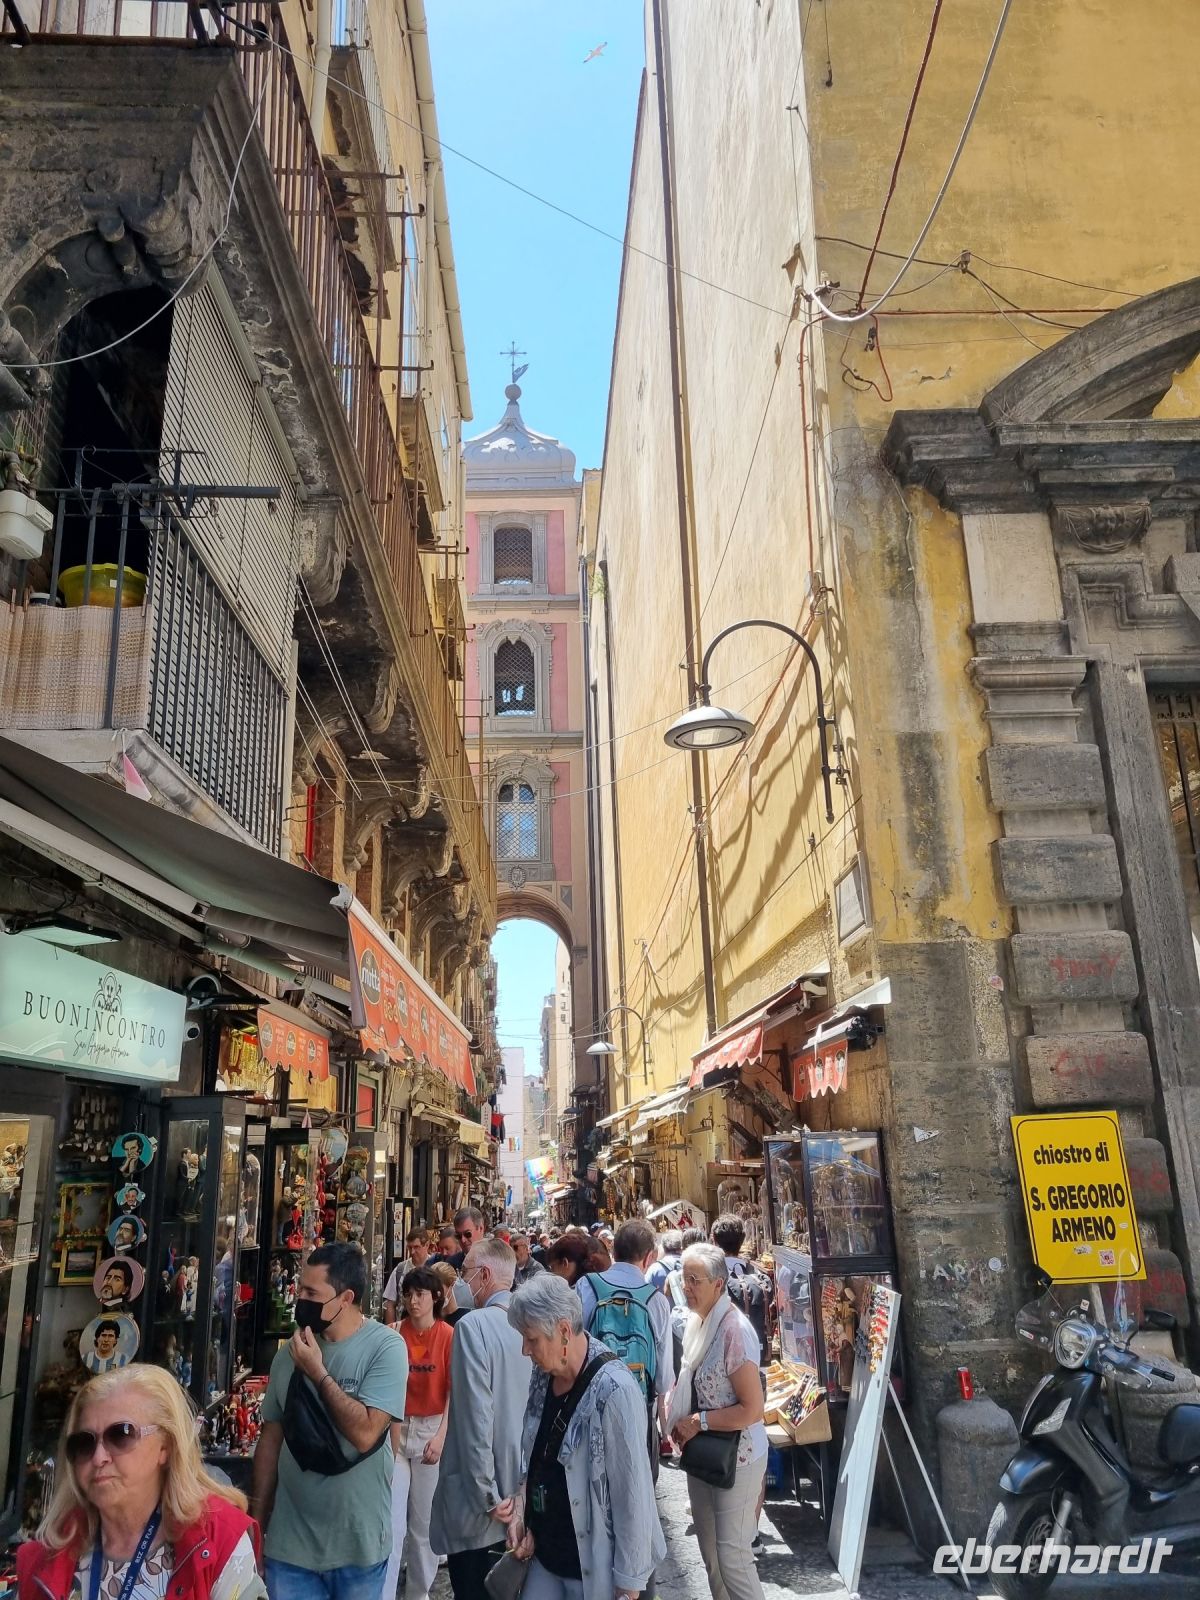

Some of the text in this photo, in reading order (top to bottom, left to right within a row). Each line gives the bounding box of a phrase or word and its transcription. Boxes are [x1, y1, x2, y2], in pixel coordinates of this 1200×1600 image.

[23, 990, 166, 1048] BUONINCONTRO
[1033, 1142, 1110, 1165] chiostro di
[1030, 1183, 1126, 1211] S. GREGORIO
[1052, 1215, 1116, 1243] ARMENO
[408, 1363, 436, 1373] esse
[141, 1540, 148, 1550] OR
[145, 1525, 155, 1539] FUN
[125, 1576, 134, 1590] FUN
